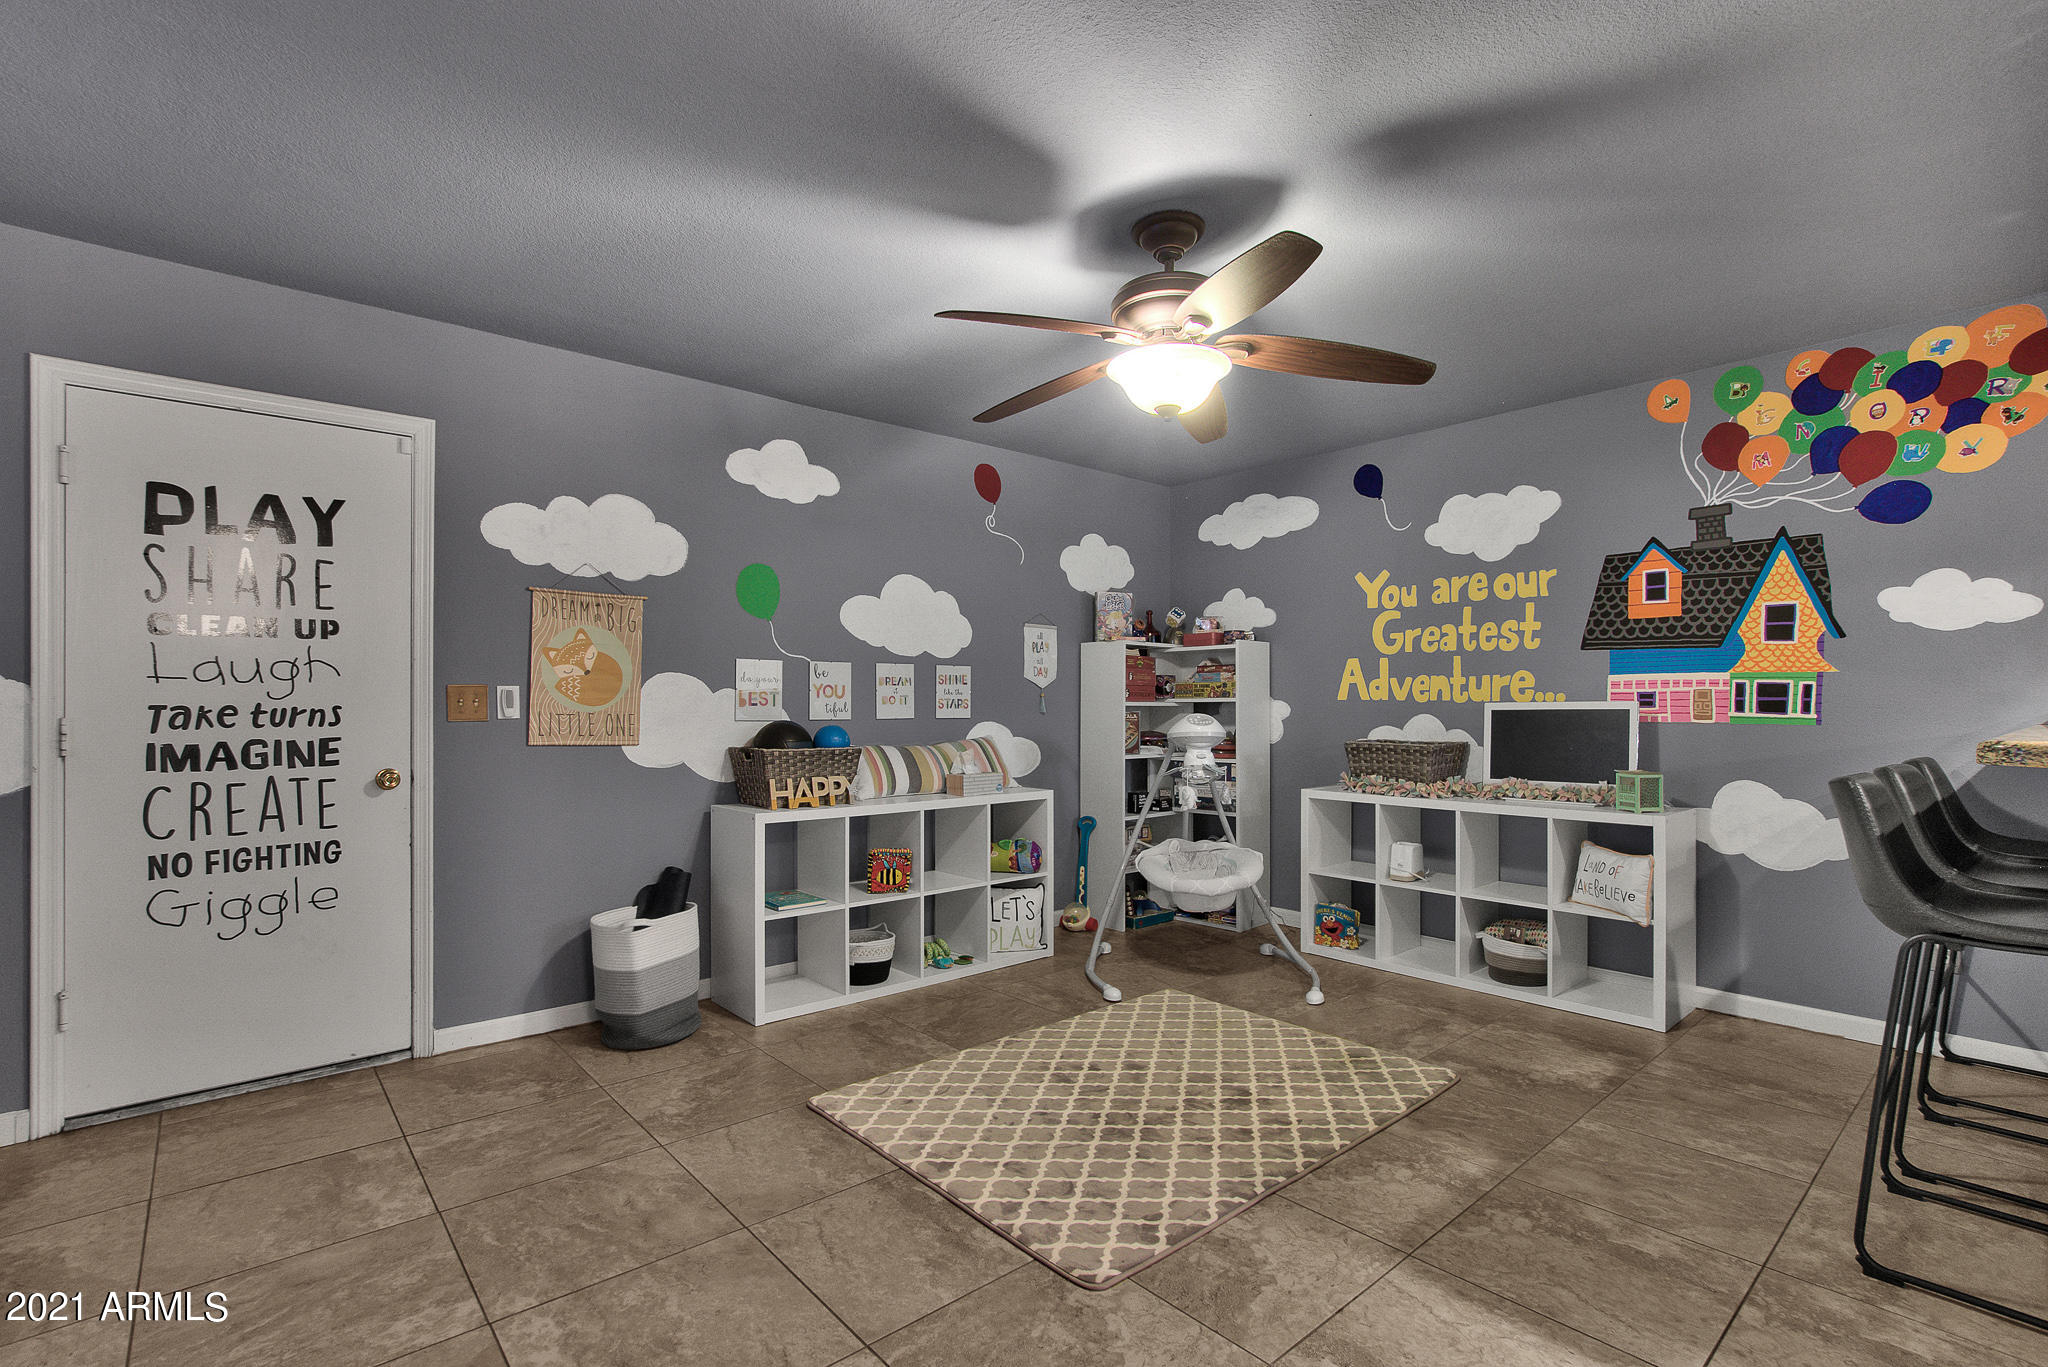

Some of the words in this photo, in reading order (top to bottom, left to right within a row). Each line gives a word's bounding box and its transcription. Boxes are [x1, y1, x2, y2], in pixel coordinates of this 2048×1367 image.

[1729, 382, 1748, 399] B
[1909, 407, 1931, 426] P
[1795, 422, 1813, 440] N
[1752, 452, 1772, 470] M
[144, 481, 346, 547] PLAY
[143, 543, 335, 611] SHARE
[1354, 569, 1418, 609] You
[1431, 572, 1488, 604] are
[1493, 567, 1557, 601] our
[147, 612, 279, 639] CLEAN
[294, 618, 340, 640] UP
[541, 597, 590, 622] DREAM
[607, 602, 637, 633] BIG
[1372, 602, 1542, 655] Greatest
[147, 642, 341, 700] Laugh
[756, 676, 779, 688] your
[813, 663, 829, 679] be
[878, 676, 912, 687] DREAM
[938, 674, 968, 686] SHINE
[1033, 666, 1048, 678] DAY
[1337, 655, 1566, 703] Adventure...
[813, 683, 846, 699] YOU
[938, 698, 969, 710] STARS
[148, 704, 237, 734] Take
[252, 702, 342, 729] turns
[825, 702, 849, 718] tiful
[538, 713, 595, 738] LITTLE
[605, 713, 636, 737] ONE
[145, 737, 341, 773] IMAGINE
[769, 776, 855, 810] HAPPY
[142, 776, 338, 841] CREATE
[147, 853, 193, 881] NO
[205, 840, 342, 875] FIGHTING
[146, 877, 338, 940] Giggle
[991, 895, 1036, 922] LET'S
[990, 925, 1036, 951] PLAY
